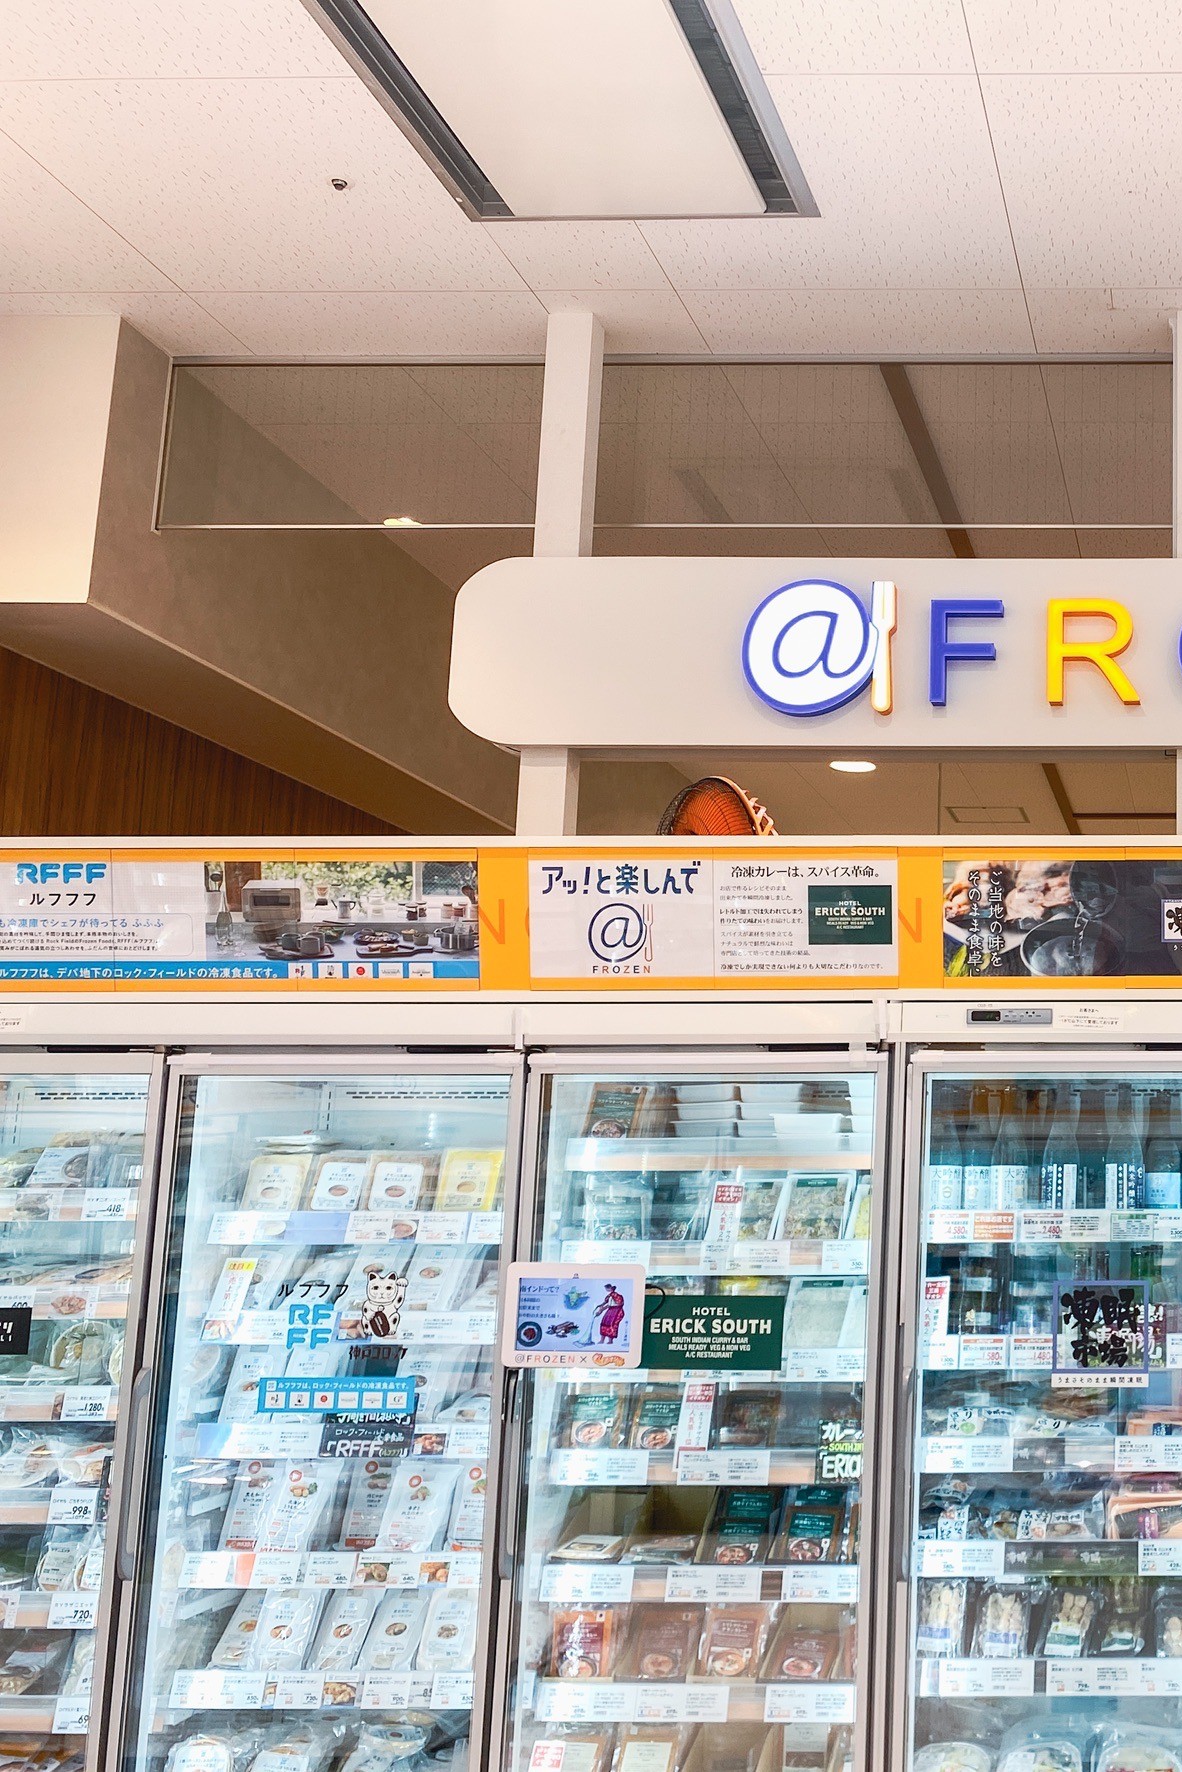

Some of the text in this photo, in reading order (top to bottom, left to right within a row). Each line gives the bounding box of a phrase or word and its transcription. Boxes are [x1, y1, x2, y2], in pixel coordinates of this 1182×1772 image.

[16, 863, 107, 884] RFFF
[731, 866, 880, 878] 冷凍カレーは、スパイス革命。
[29, 893, 97, 907] ルフフフ
[815, 907, 886, 916] ERICK SOUTH
[988, 871, 1004, 967] ご当地の味を
[592, 965, 651, 974] FROZEN
[279, 1284, 349, 1298] ルフフフ
[692, 1307, 731, 1316] HOTEL
[650, 1318, 772, 1334] ERICK SOUTH
[72, 1505, 89, 1515] 998
[72, 1610, 90, 1619] 720
